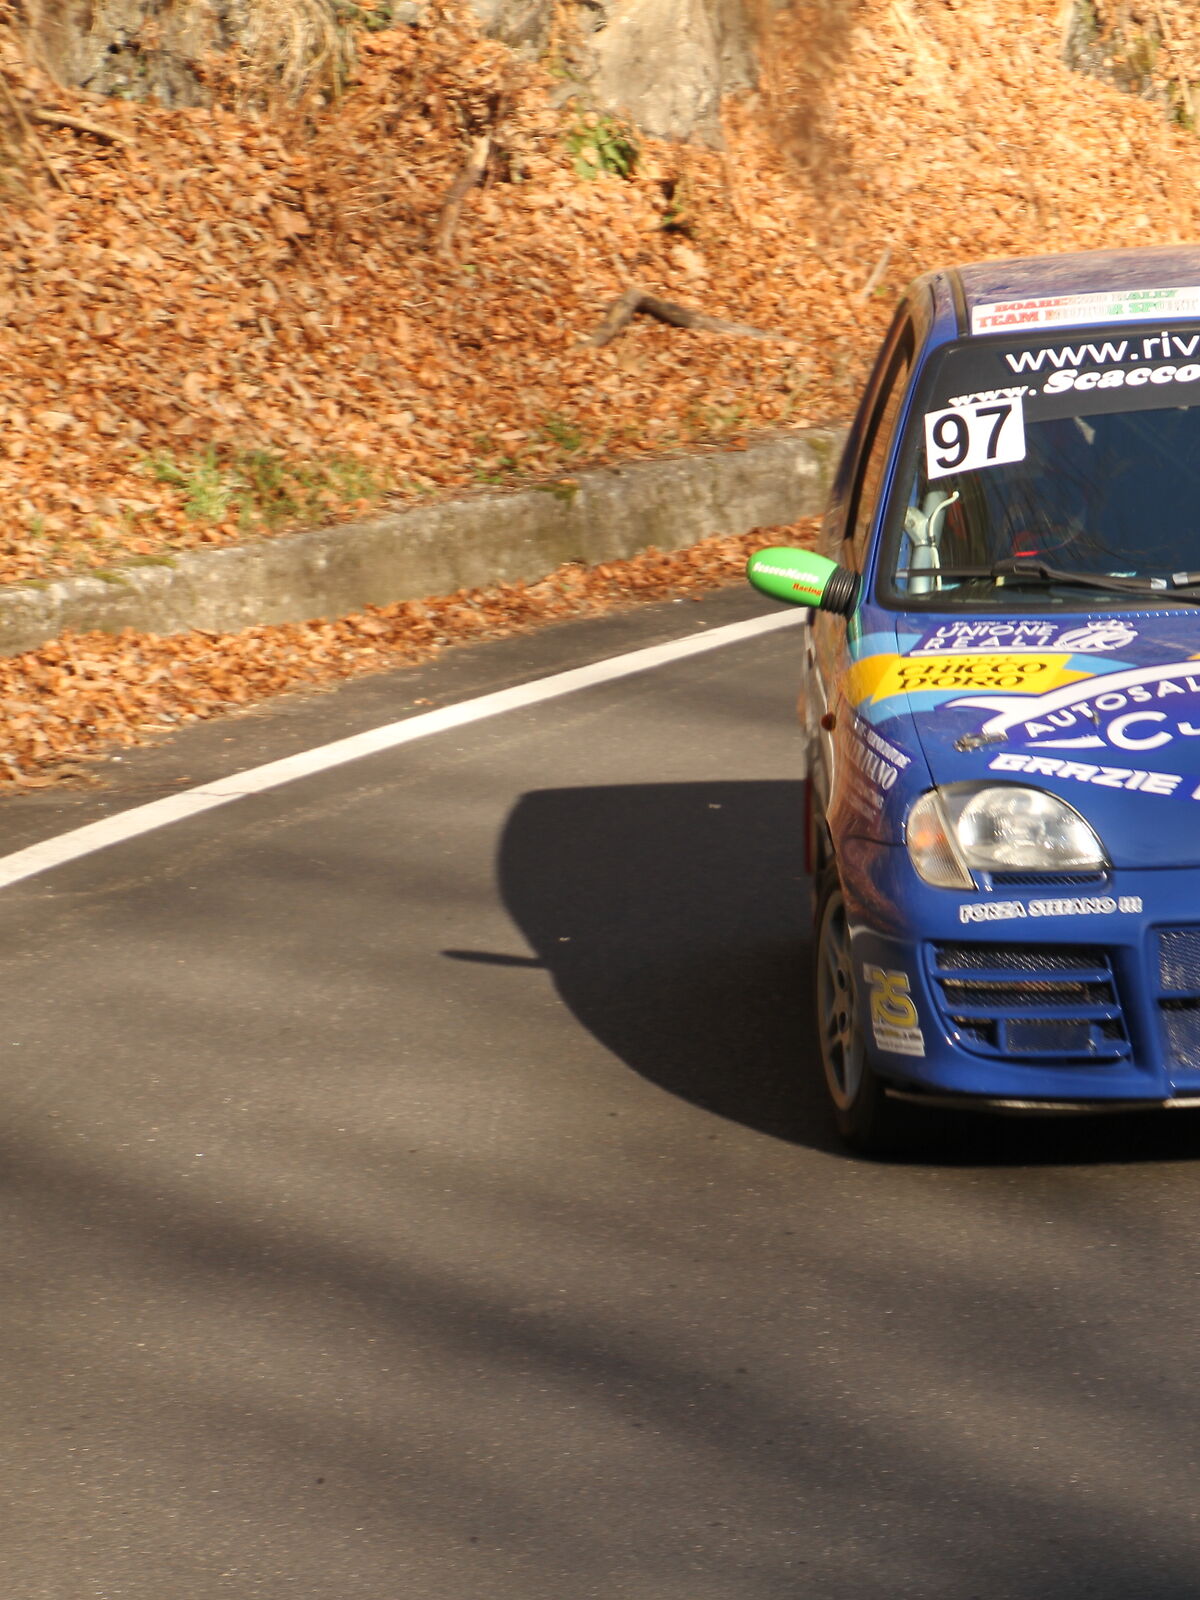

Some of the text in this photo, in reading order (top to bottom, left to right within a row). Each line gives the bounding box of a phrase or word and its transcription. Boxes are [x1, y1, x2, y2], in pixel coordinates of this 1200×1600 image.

[976, 309, 1039, 328] TEAM
[932, 404, 1013, 469] 97
[792, 582, 823, 596] Racing
[936, 624, 1059, 639] UNIONE
[923, 635, 1050, 650] REALI
[898, 661, 1049, 676] CHICCO
[988, 752, 1183, 796] GRAZIE
[959, 901, 1027, 924] FORZA
[1028, 896, 1117, 917] STEFANO
